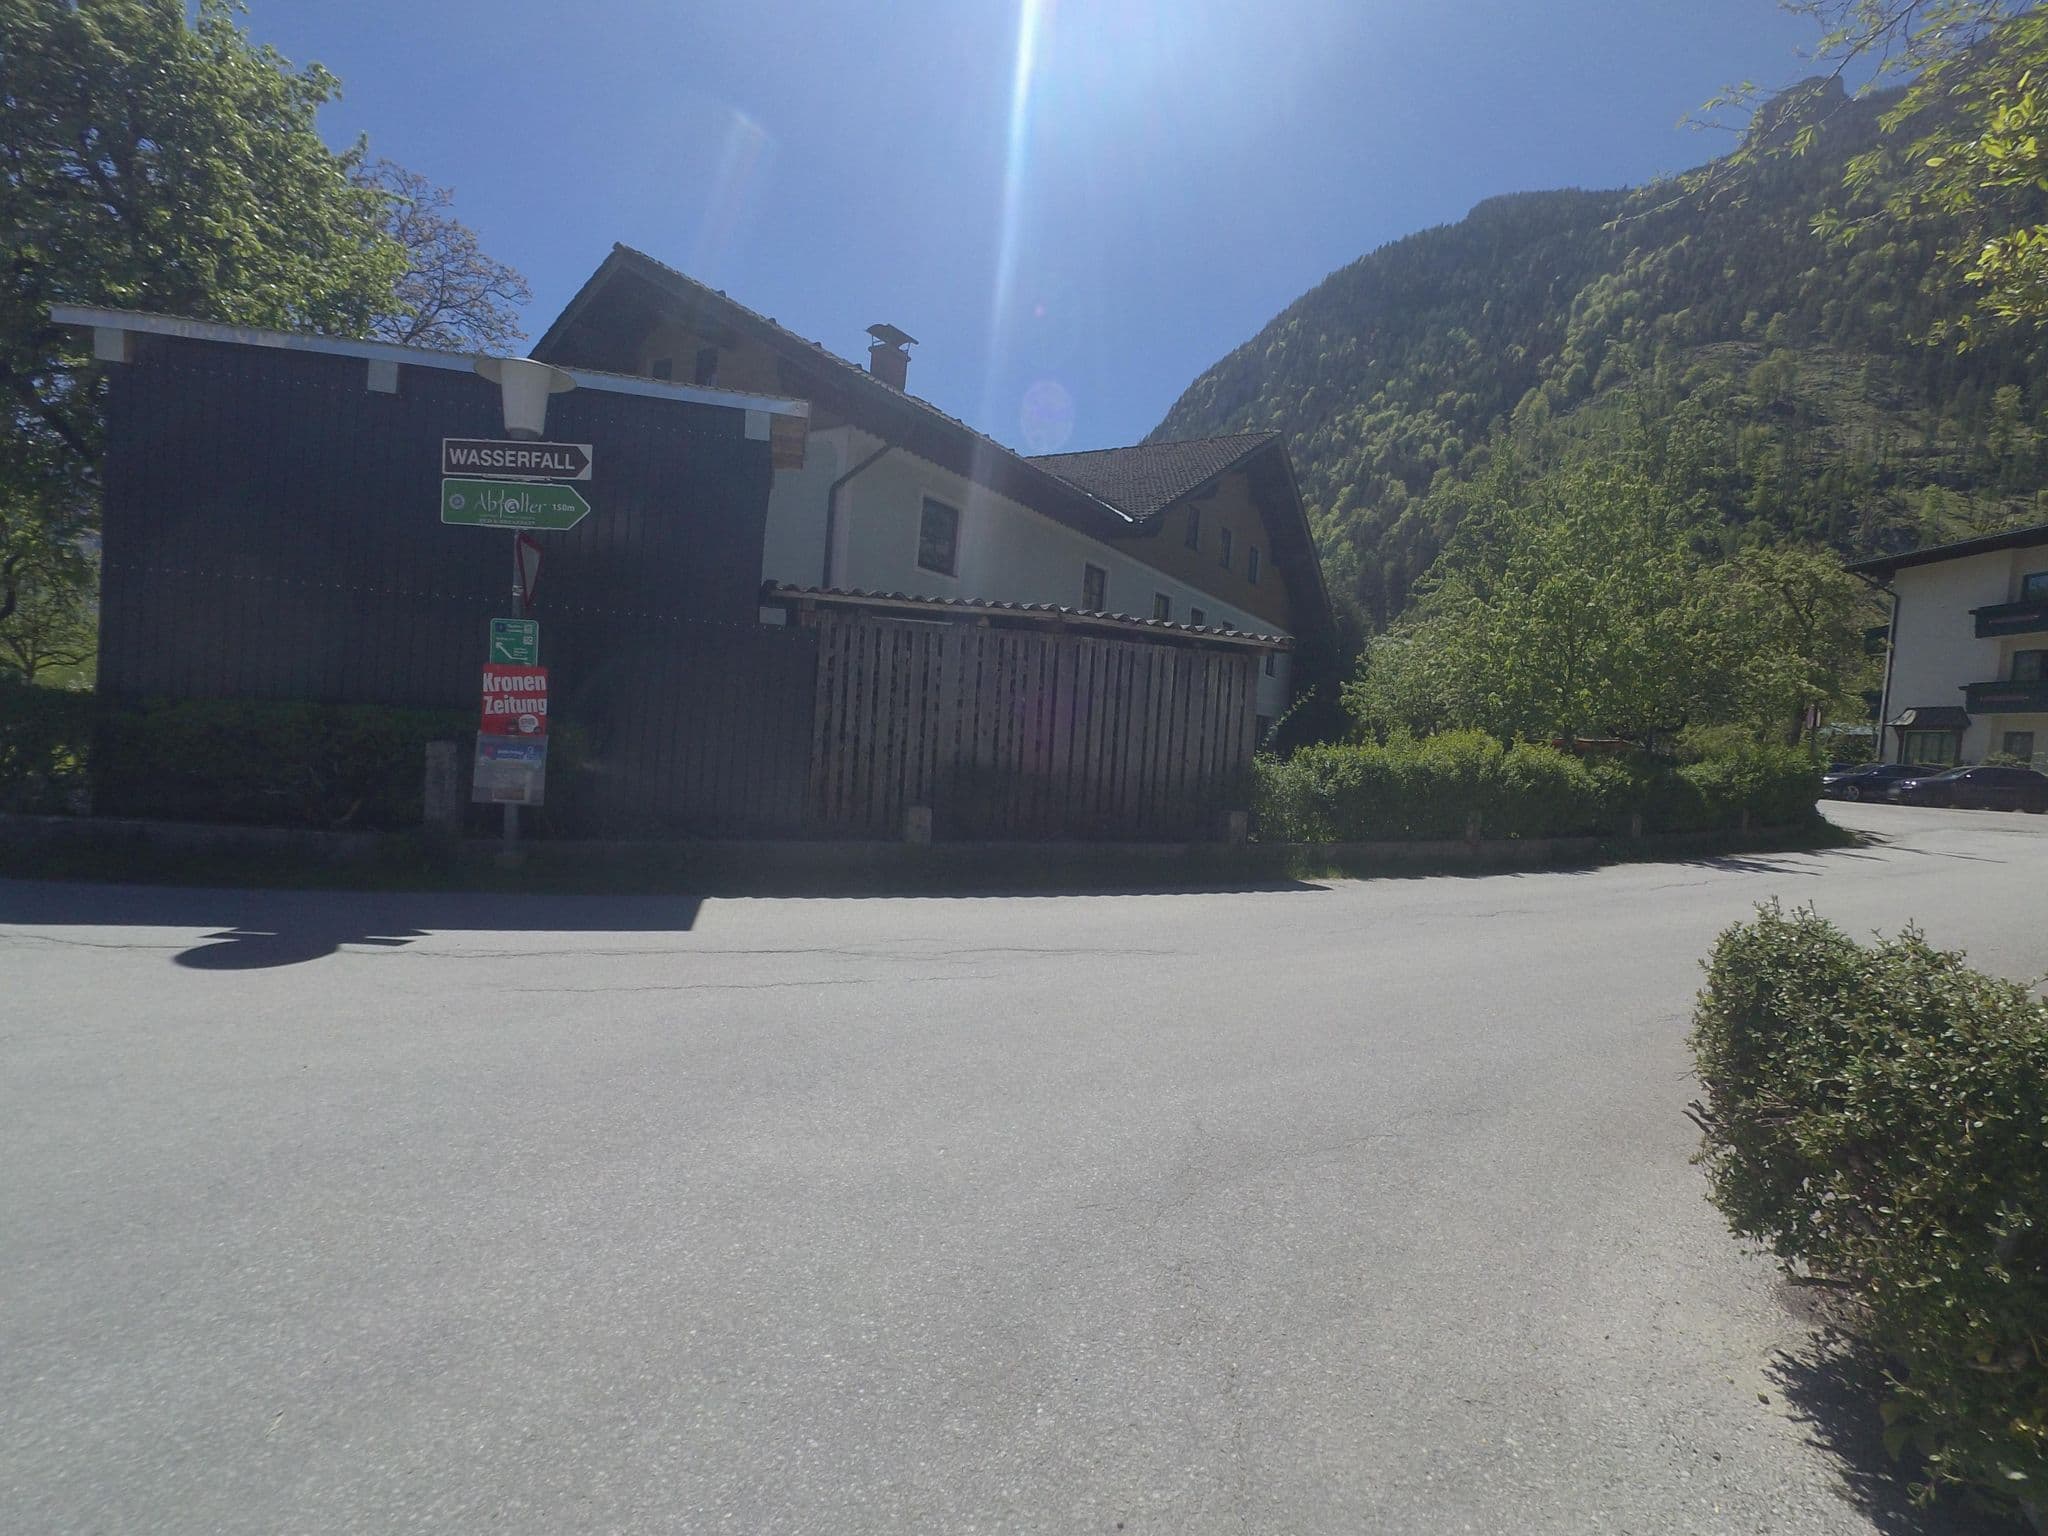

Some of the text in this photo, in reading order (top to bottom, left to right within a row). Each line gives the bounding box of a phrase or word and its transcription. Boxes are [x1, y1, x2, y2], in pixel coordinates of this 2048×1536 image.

[449, 448, 576, 470] WASSERFALL
[552, 503, 575, 512] 150m
[483, 673, 546, 692] Kronen
[484, 695, 547, 714] Zeitung
